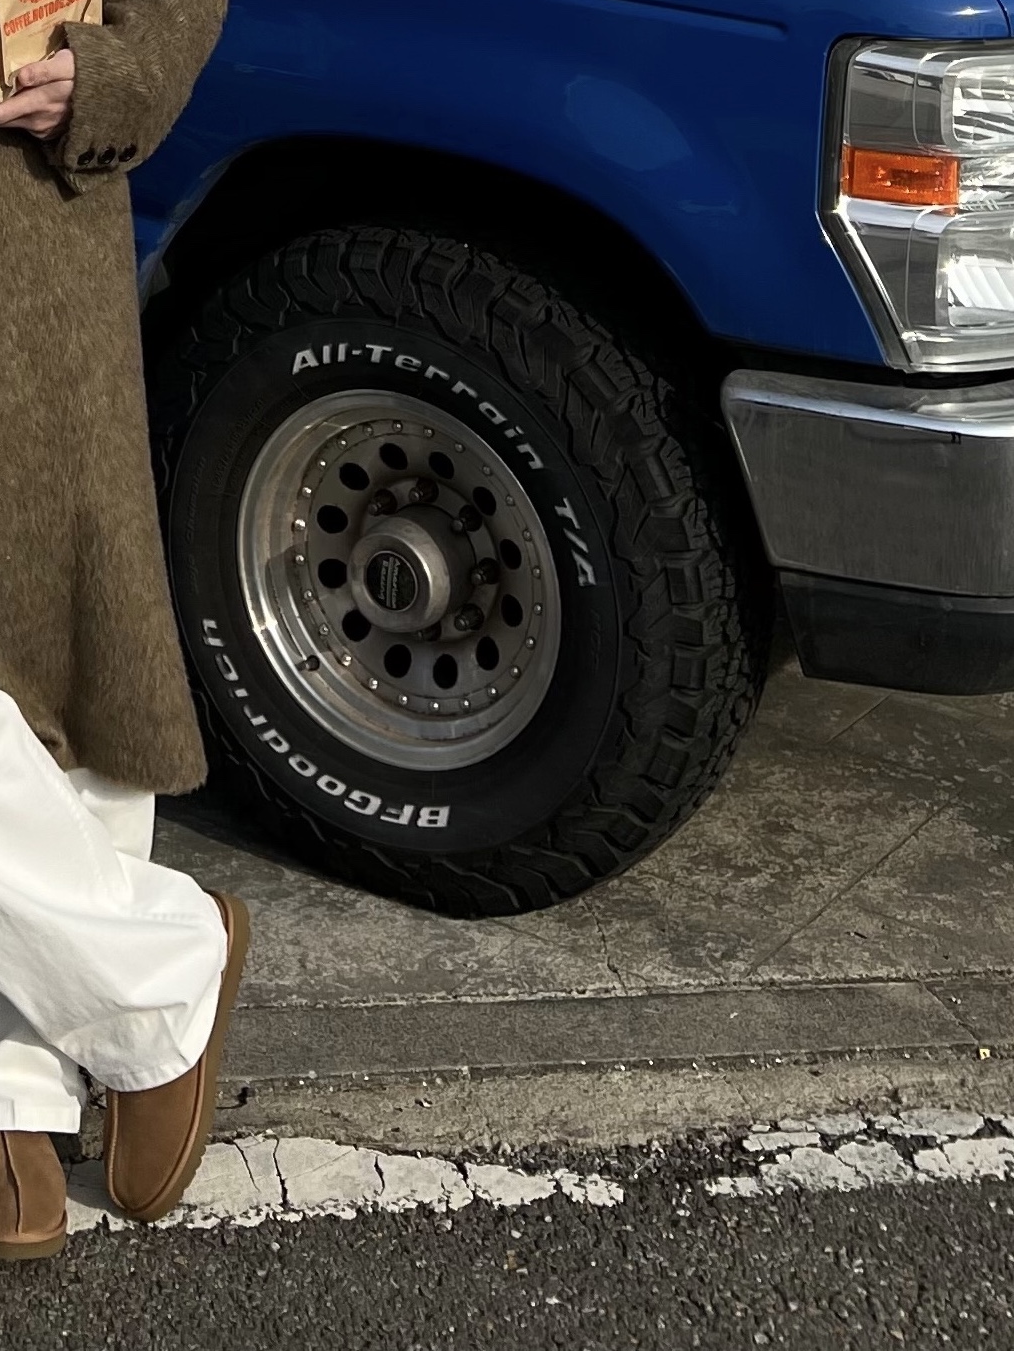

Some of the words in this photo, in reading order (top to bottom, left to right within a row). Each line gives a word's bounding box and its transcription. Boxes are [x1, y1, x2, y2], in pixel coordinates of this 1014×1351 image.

[291, 342, 546, 472] All-Terrain
[554, 497, 597, 588] T/A
[202, 617, 452, 828] BFGoodrich
